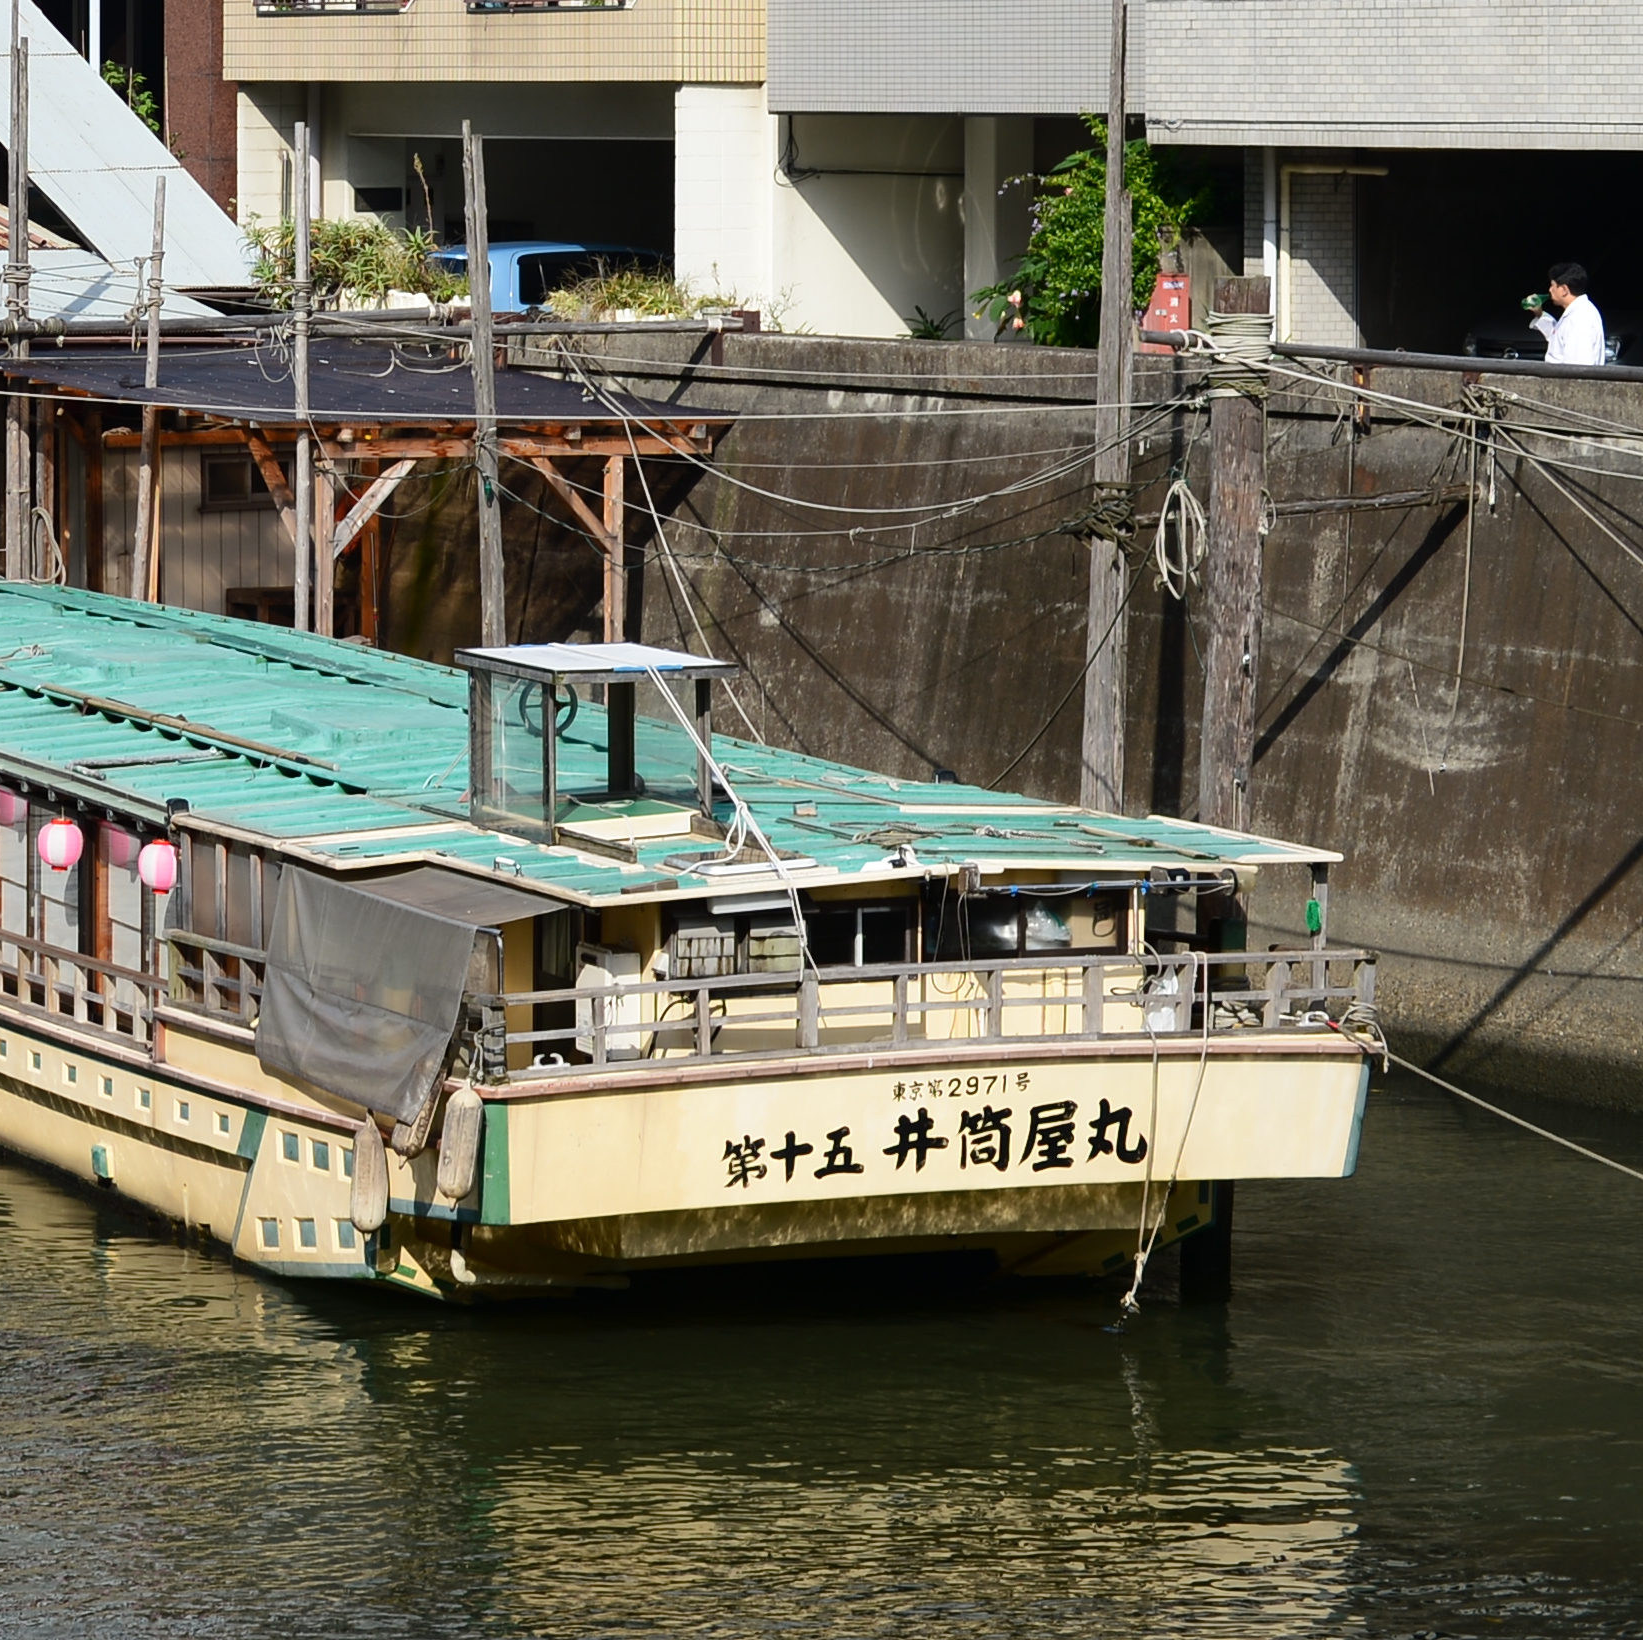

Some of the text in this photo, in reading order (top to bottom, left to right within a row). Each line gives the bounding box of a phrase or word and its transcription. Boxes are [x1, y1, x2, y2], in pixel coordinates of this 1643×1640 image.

[892, 1072, 1031, 1102] 東京第2971号
[721, 1098, 1148, 1189] 第十五 井筒屋丸
